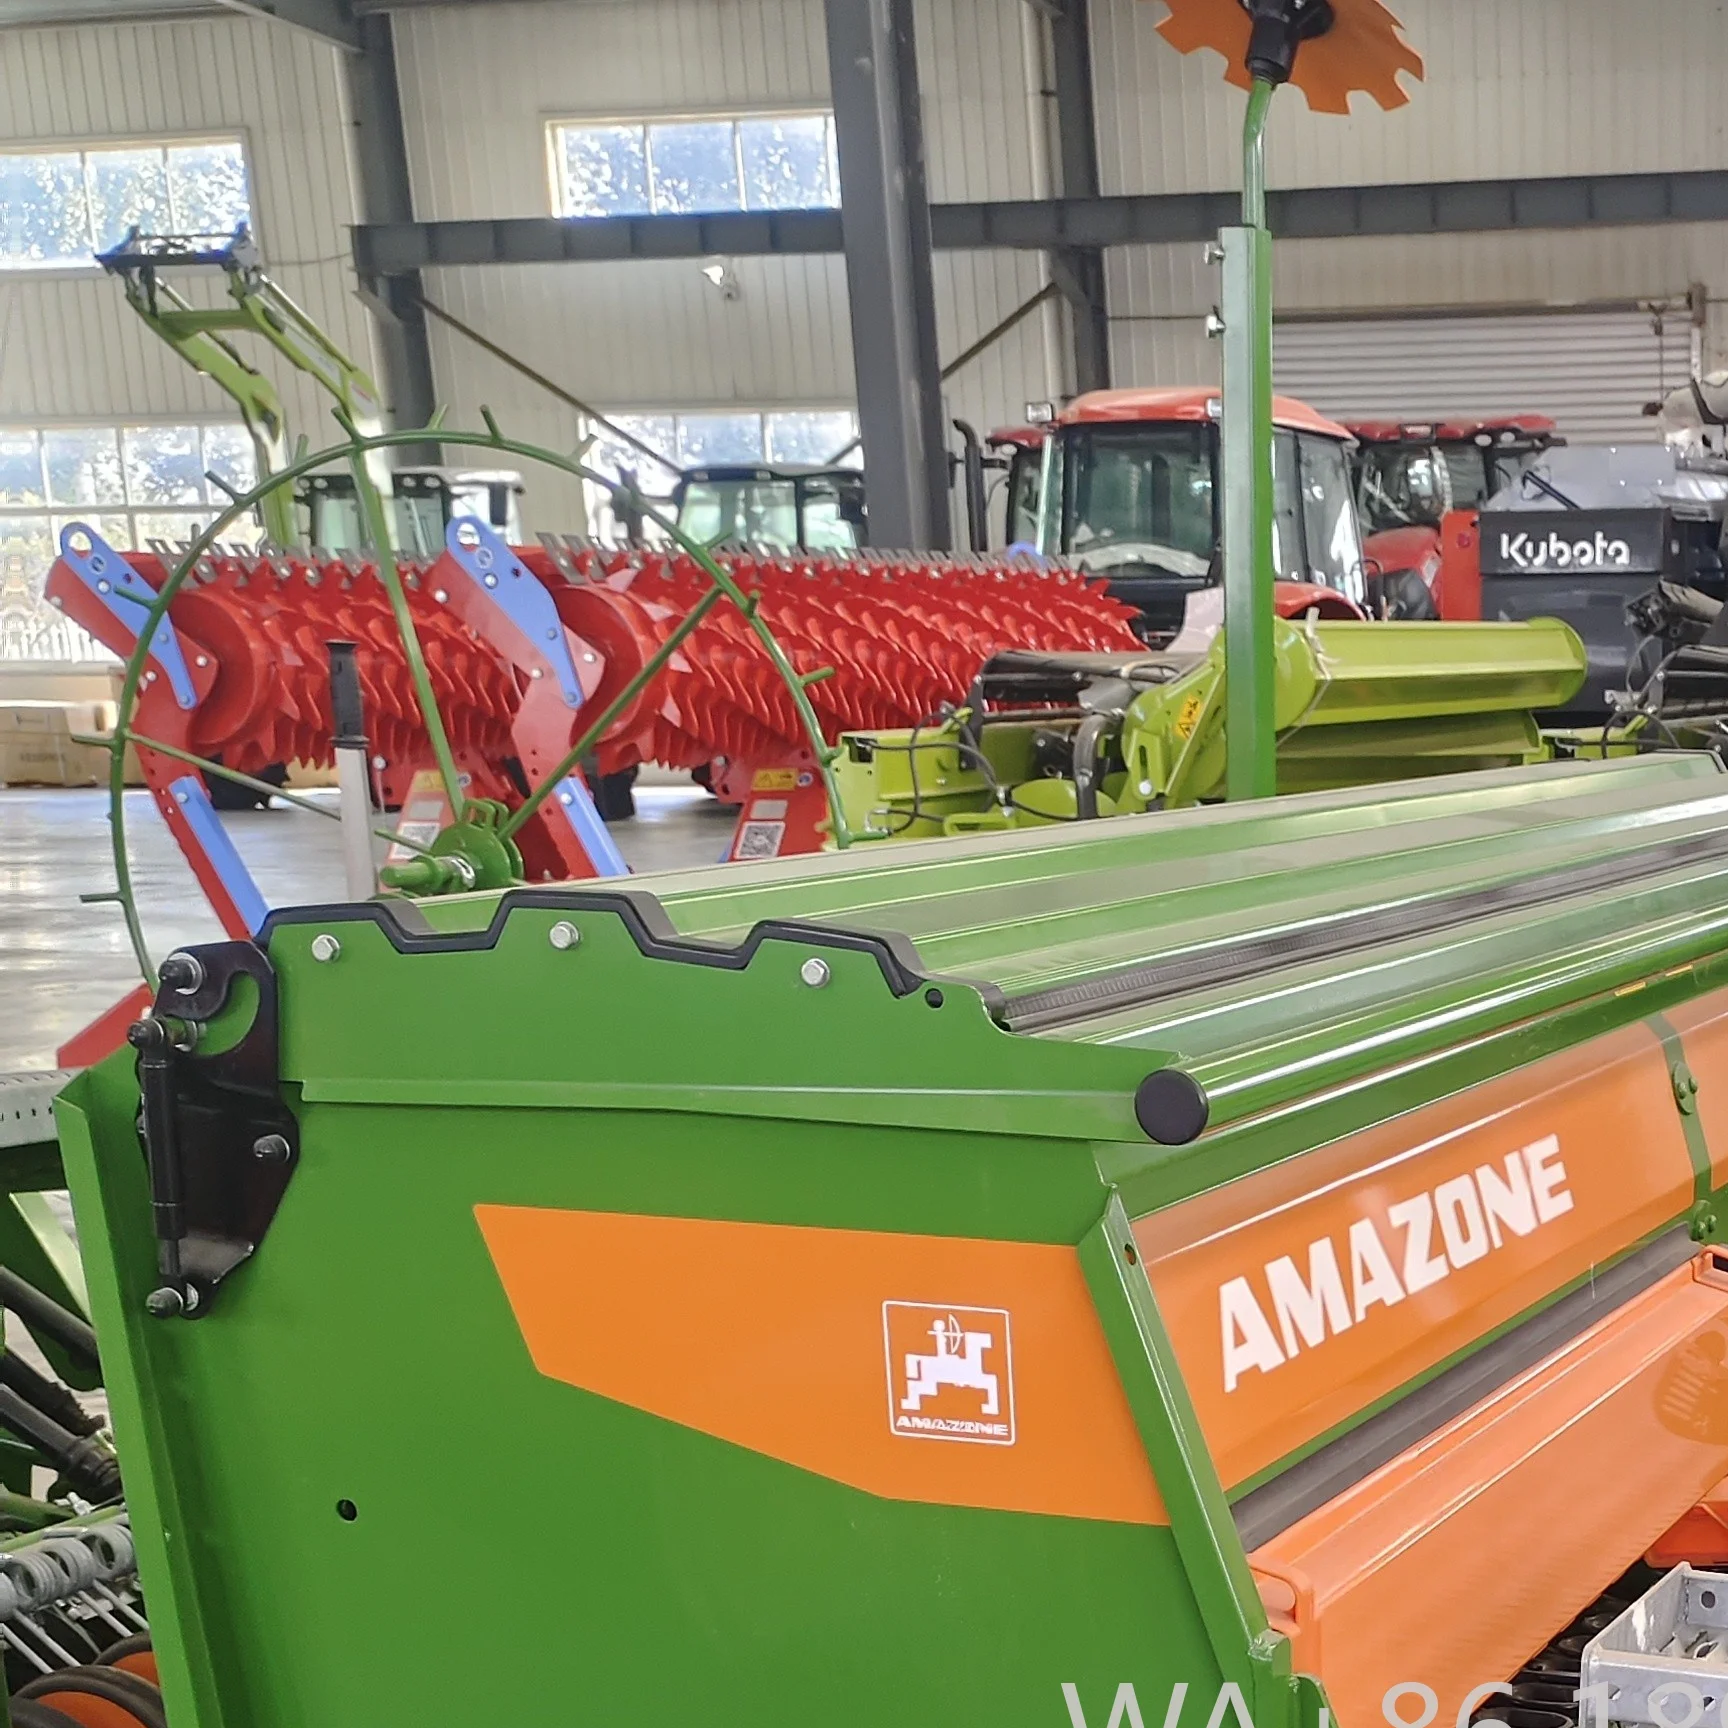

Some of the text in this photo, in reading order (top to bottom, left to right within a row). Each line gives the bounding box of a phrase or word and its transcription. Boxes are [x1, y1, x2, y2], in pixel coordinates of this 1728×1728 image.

[1500, 530, 1631, 567] Kubota
[1220, 1135, 1573, 1392] AMAZONE
[896, 1415, 1009, 1436] AMAZONE
